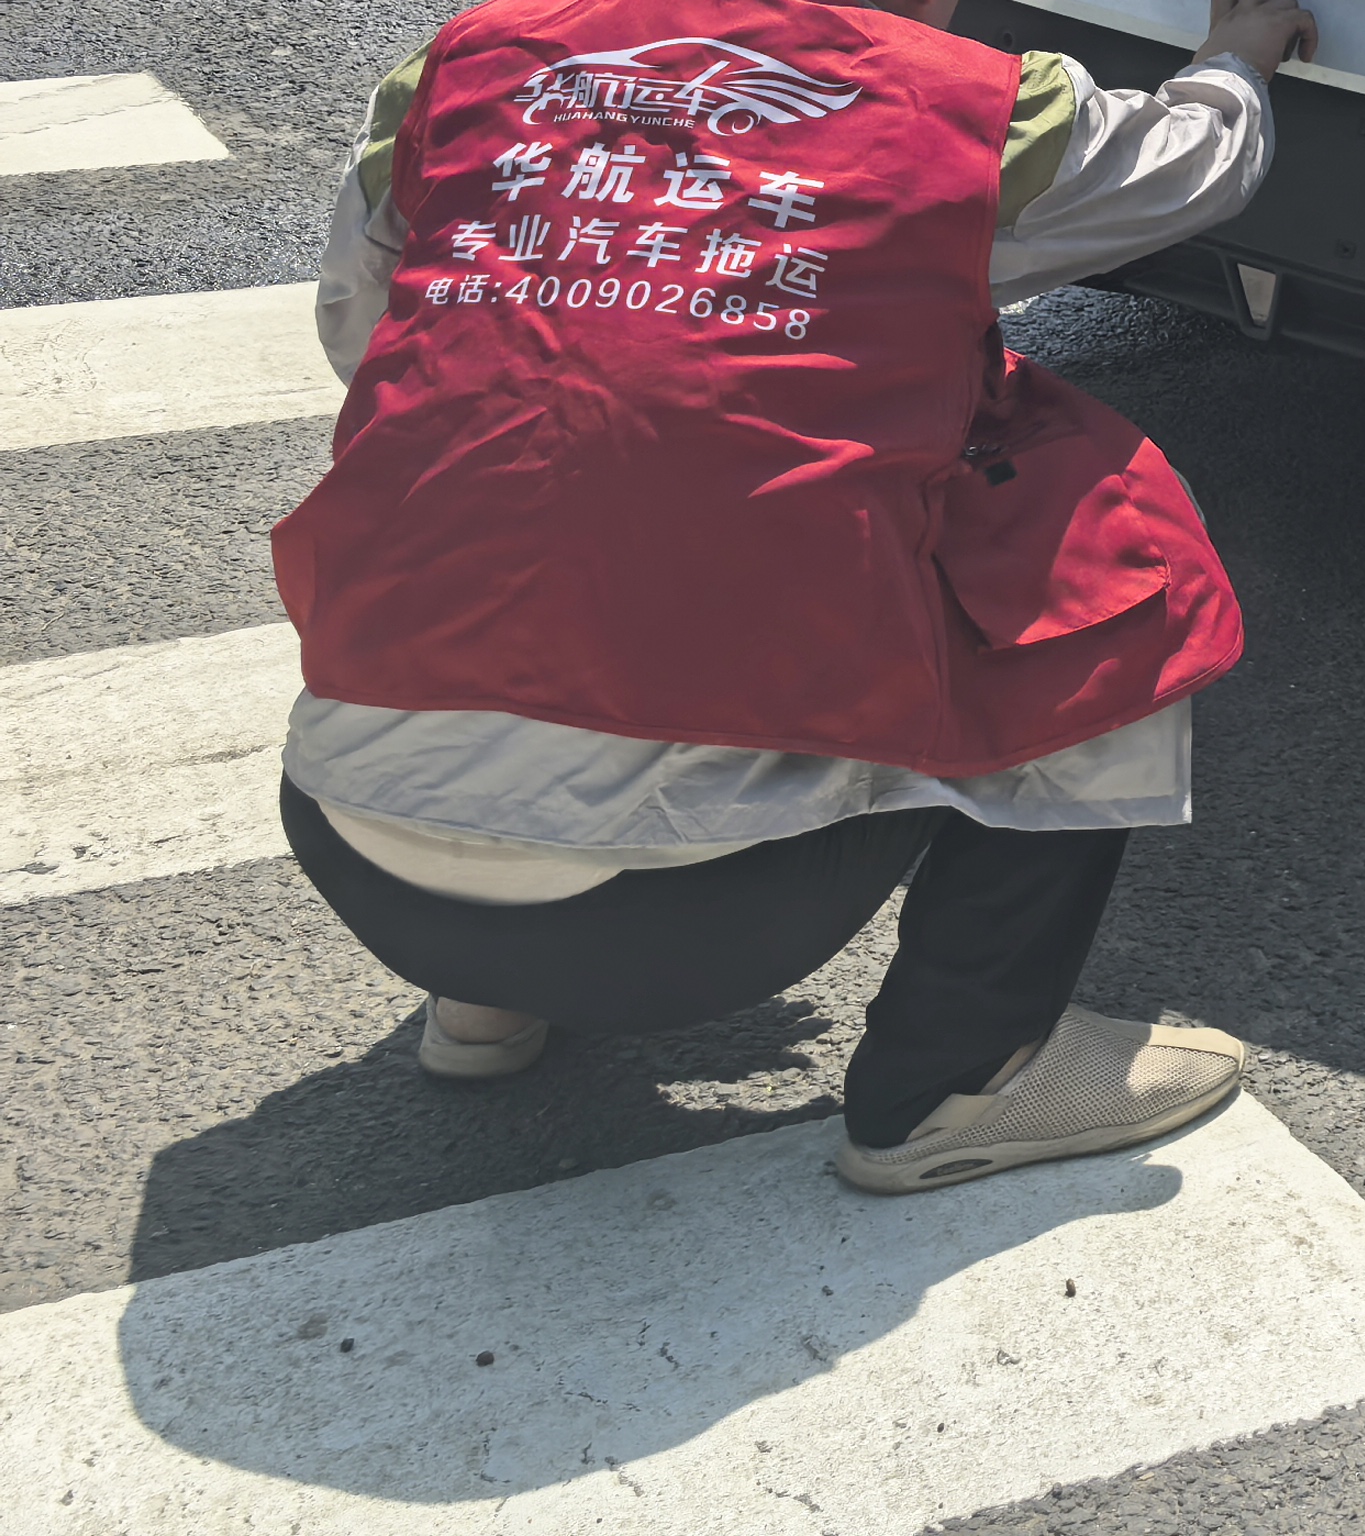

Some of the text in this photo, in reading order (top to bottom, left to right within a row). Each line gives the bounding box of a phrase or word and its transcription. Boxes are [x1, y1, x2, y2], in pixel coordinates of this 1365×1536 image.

[513, 61, 732, 124] 华航运车
[491, 141, 826, 229] 华航运车
[451, 213, 830, 299] 专业汽车拖运
